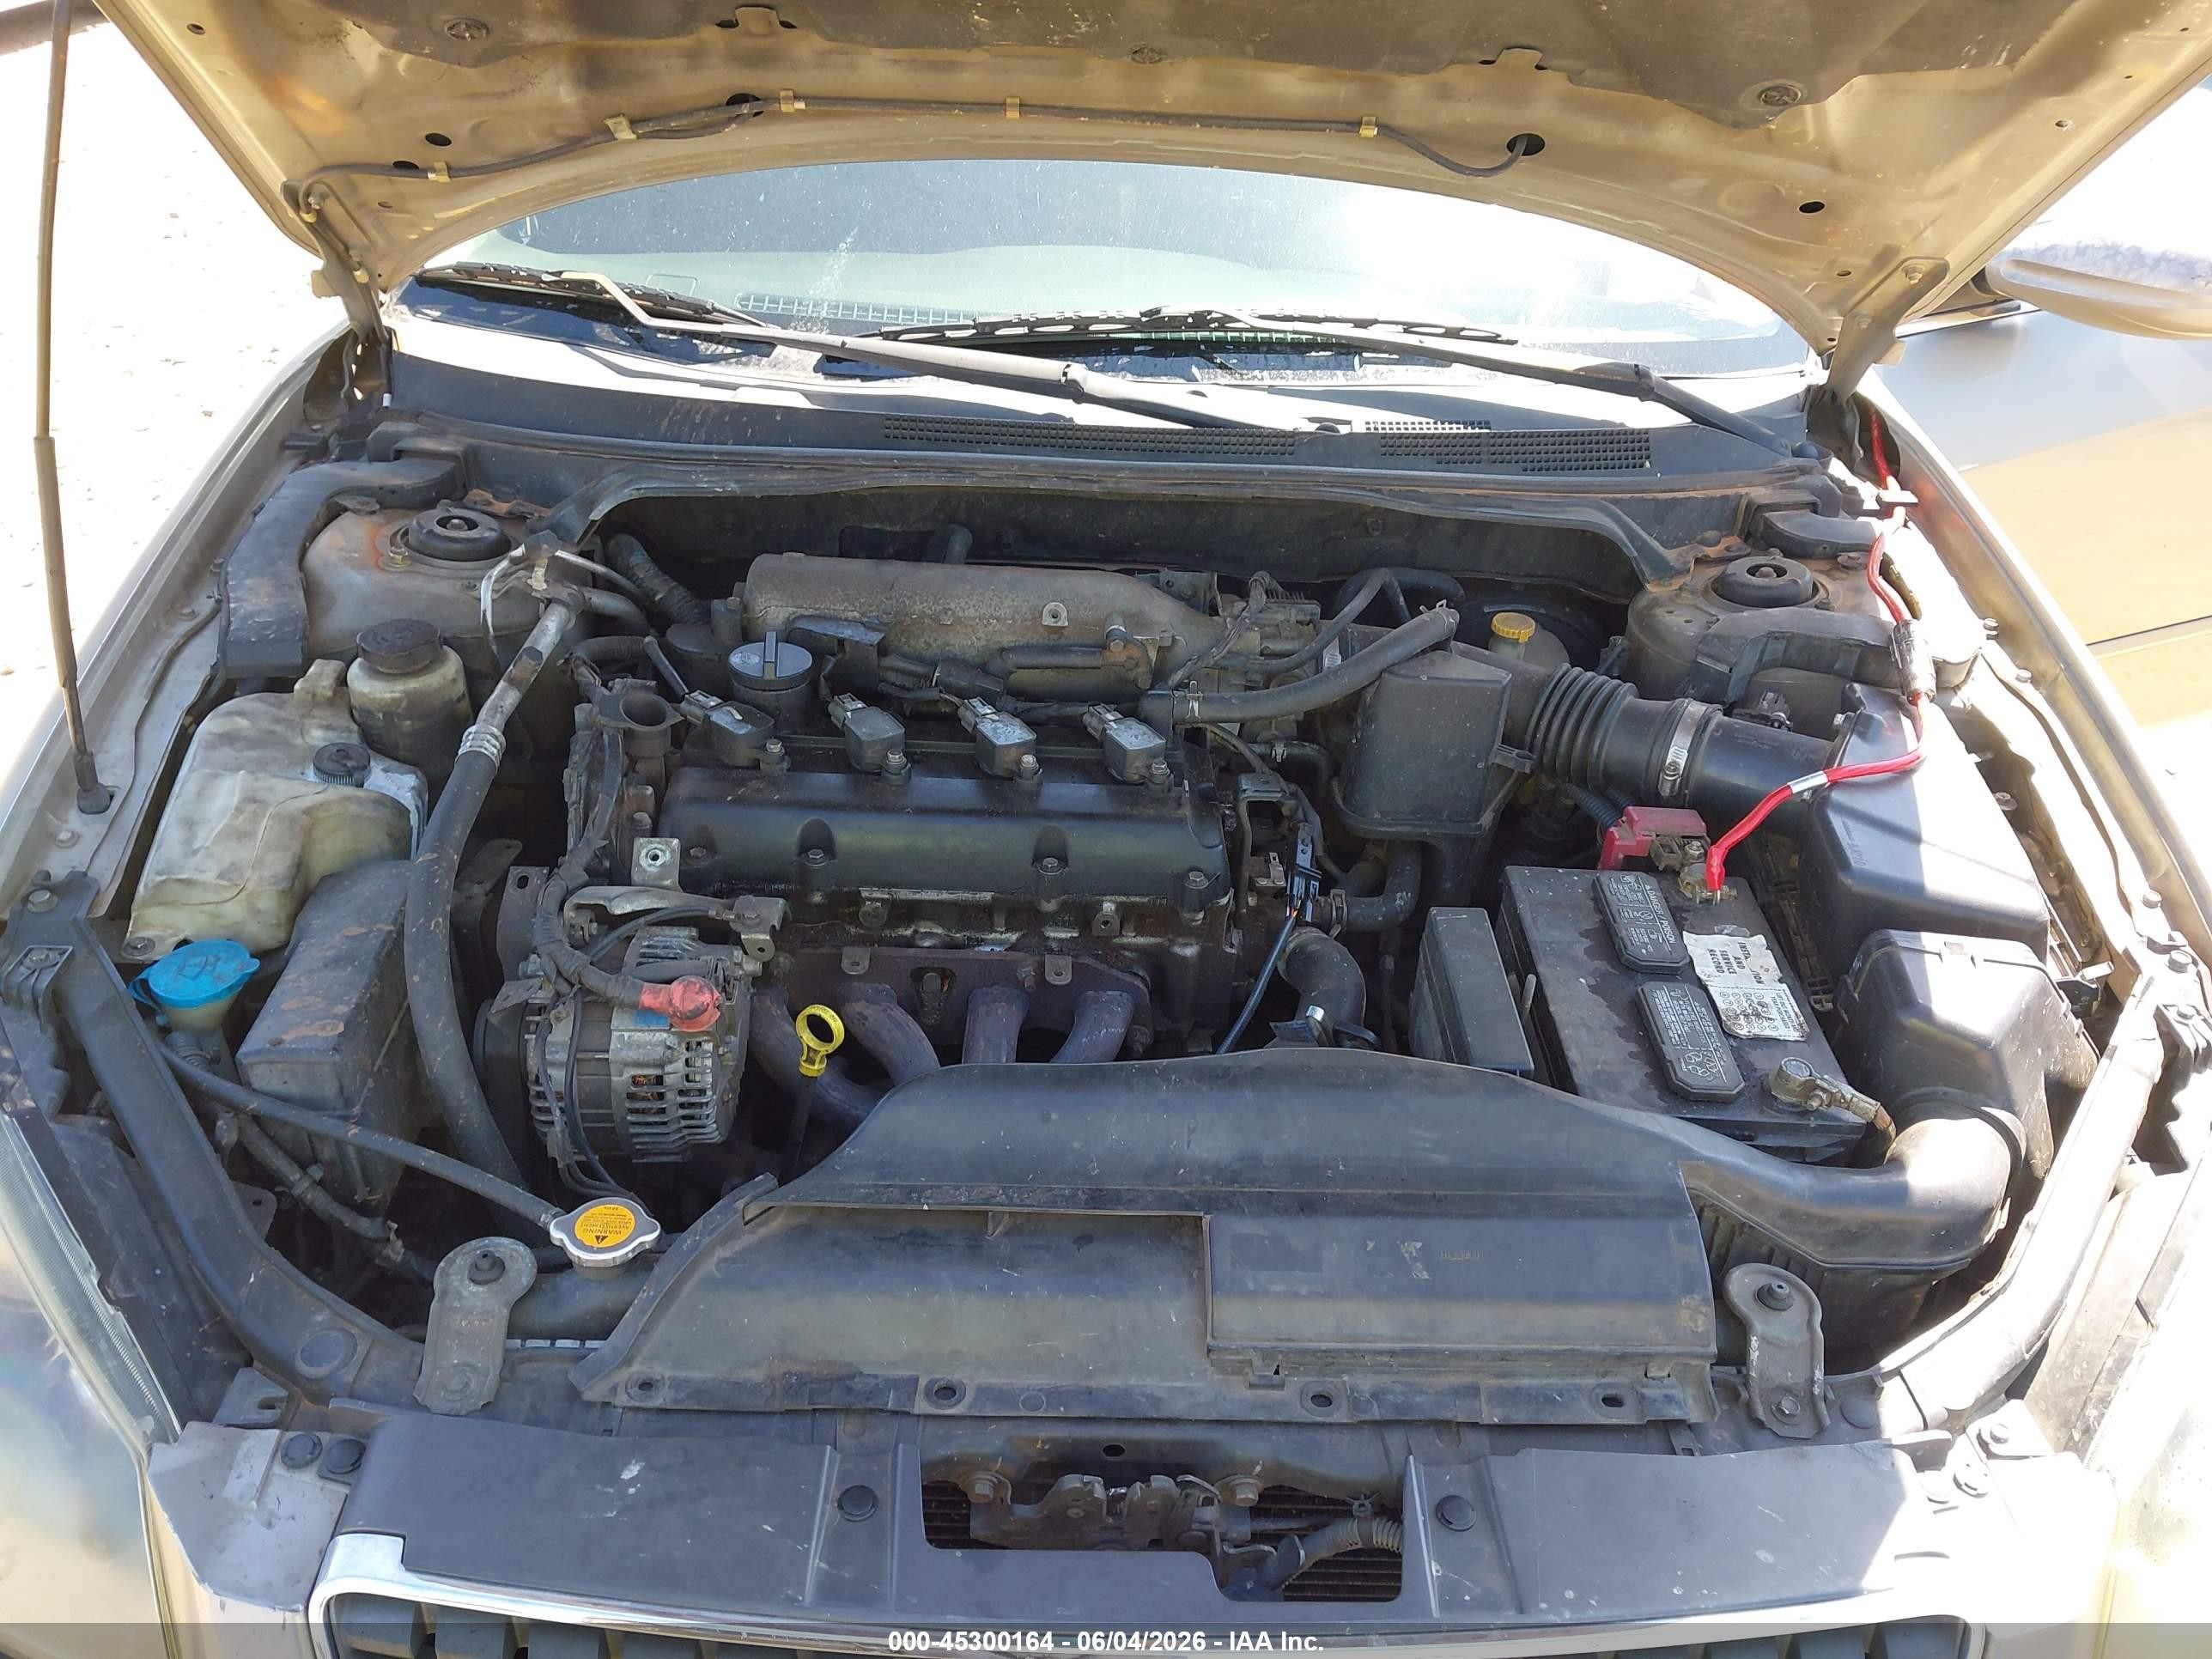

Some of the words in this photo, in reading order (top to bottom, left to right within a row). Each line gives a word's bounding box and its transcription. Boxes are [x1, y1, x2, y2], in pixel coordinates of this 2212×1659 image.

[1647, 890, 1664, 915] DANGER
[1660, 920, 1676, 944] POISON
[1707, 948, 1724, 974] RECORD
[1718, 949, 1738, 975] SERVICE
[1732, 955, 1746, 970] AND
